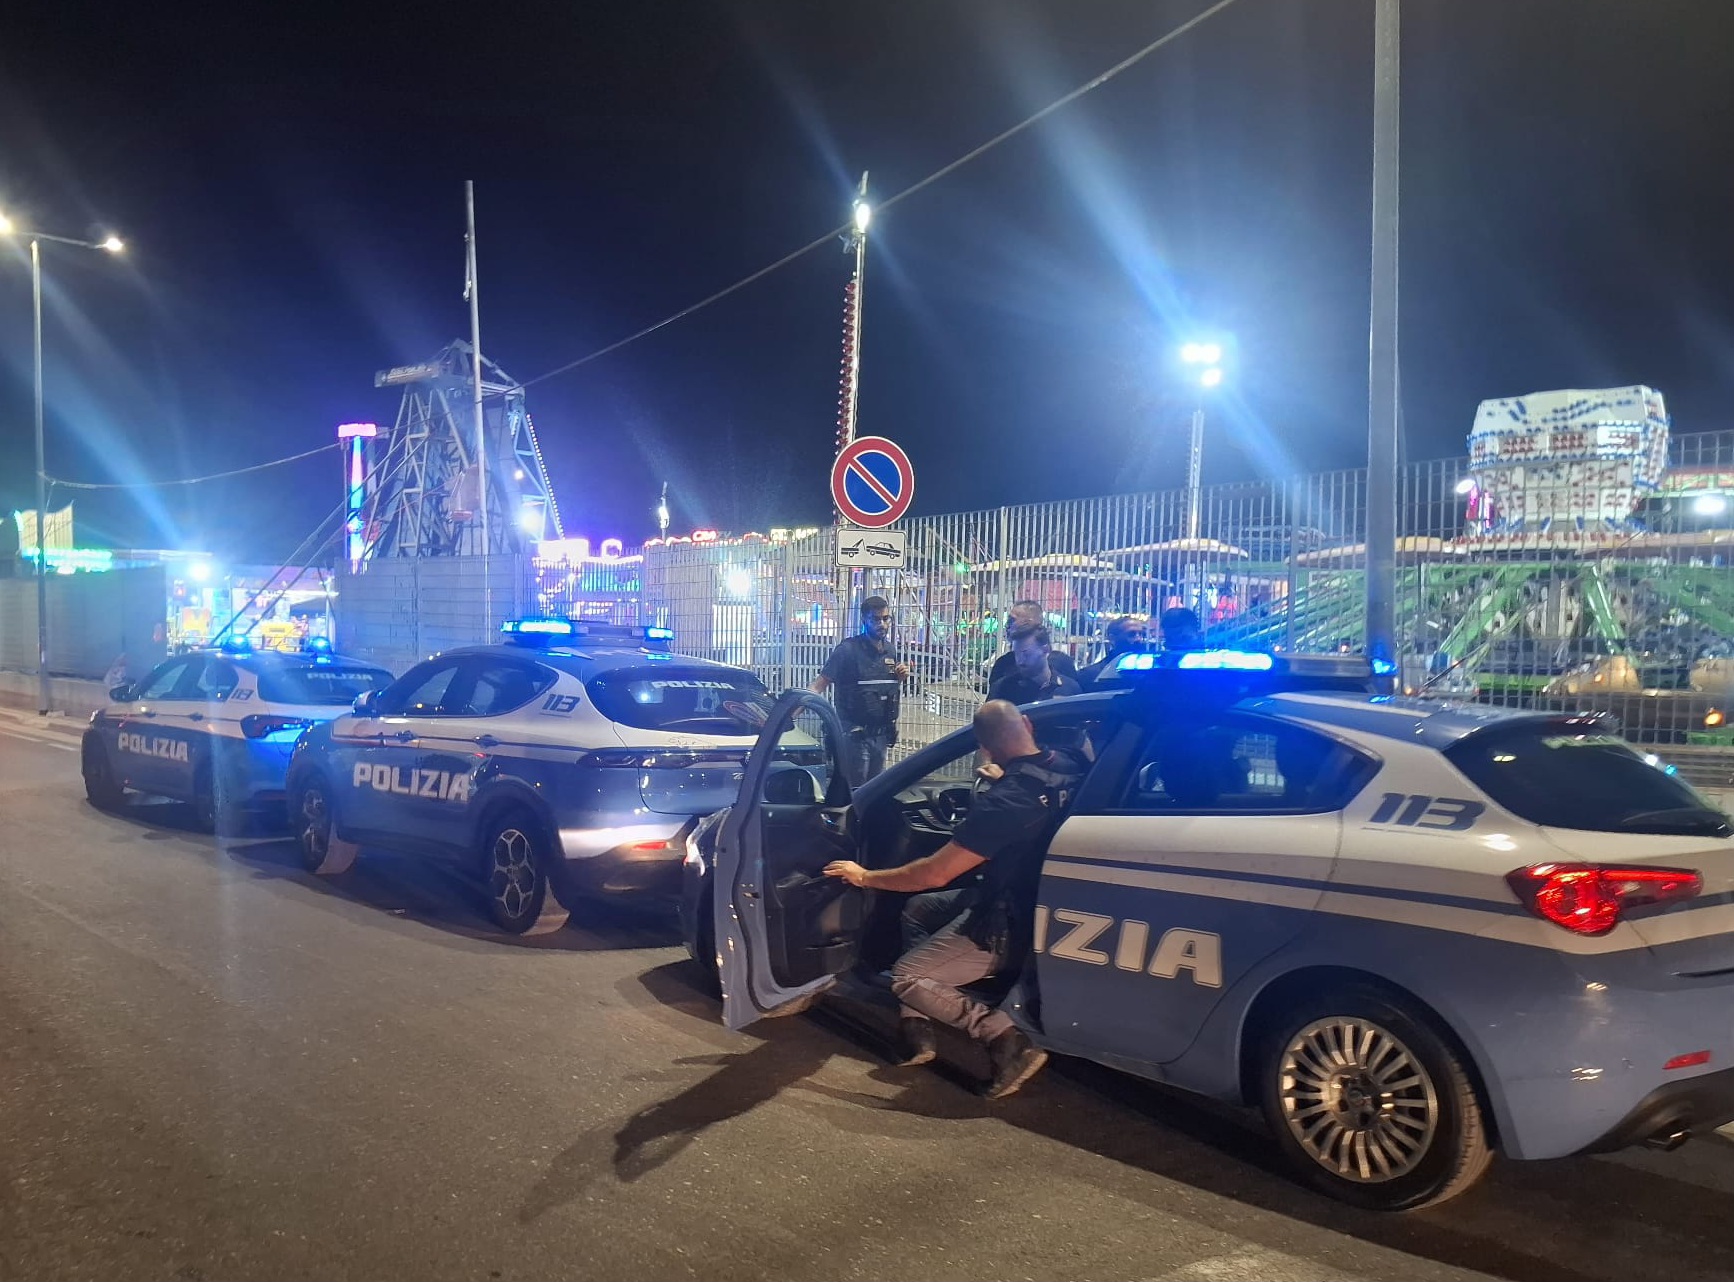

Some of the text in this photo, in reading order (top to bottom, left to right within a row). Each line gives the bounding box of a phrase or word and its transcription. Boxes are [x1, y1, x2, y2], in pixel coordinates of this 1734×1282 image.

[651, 680, 735, 690] POLIZIA
[542, 693, 580, 712] 113
[118, 731, 189, 763] POLIZIA
[353, 761, 470, 803] POLIZIA
[1369, 792, 1486, 832] 113
